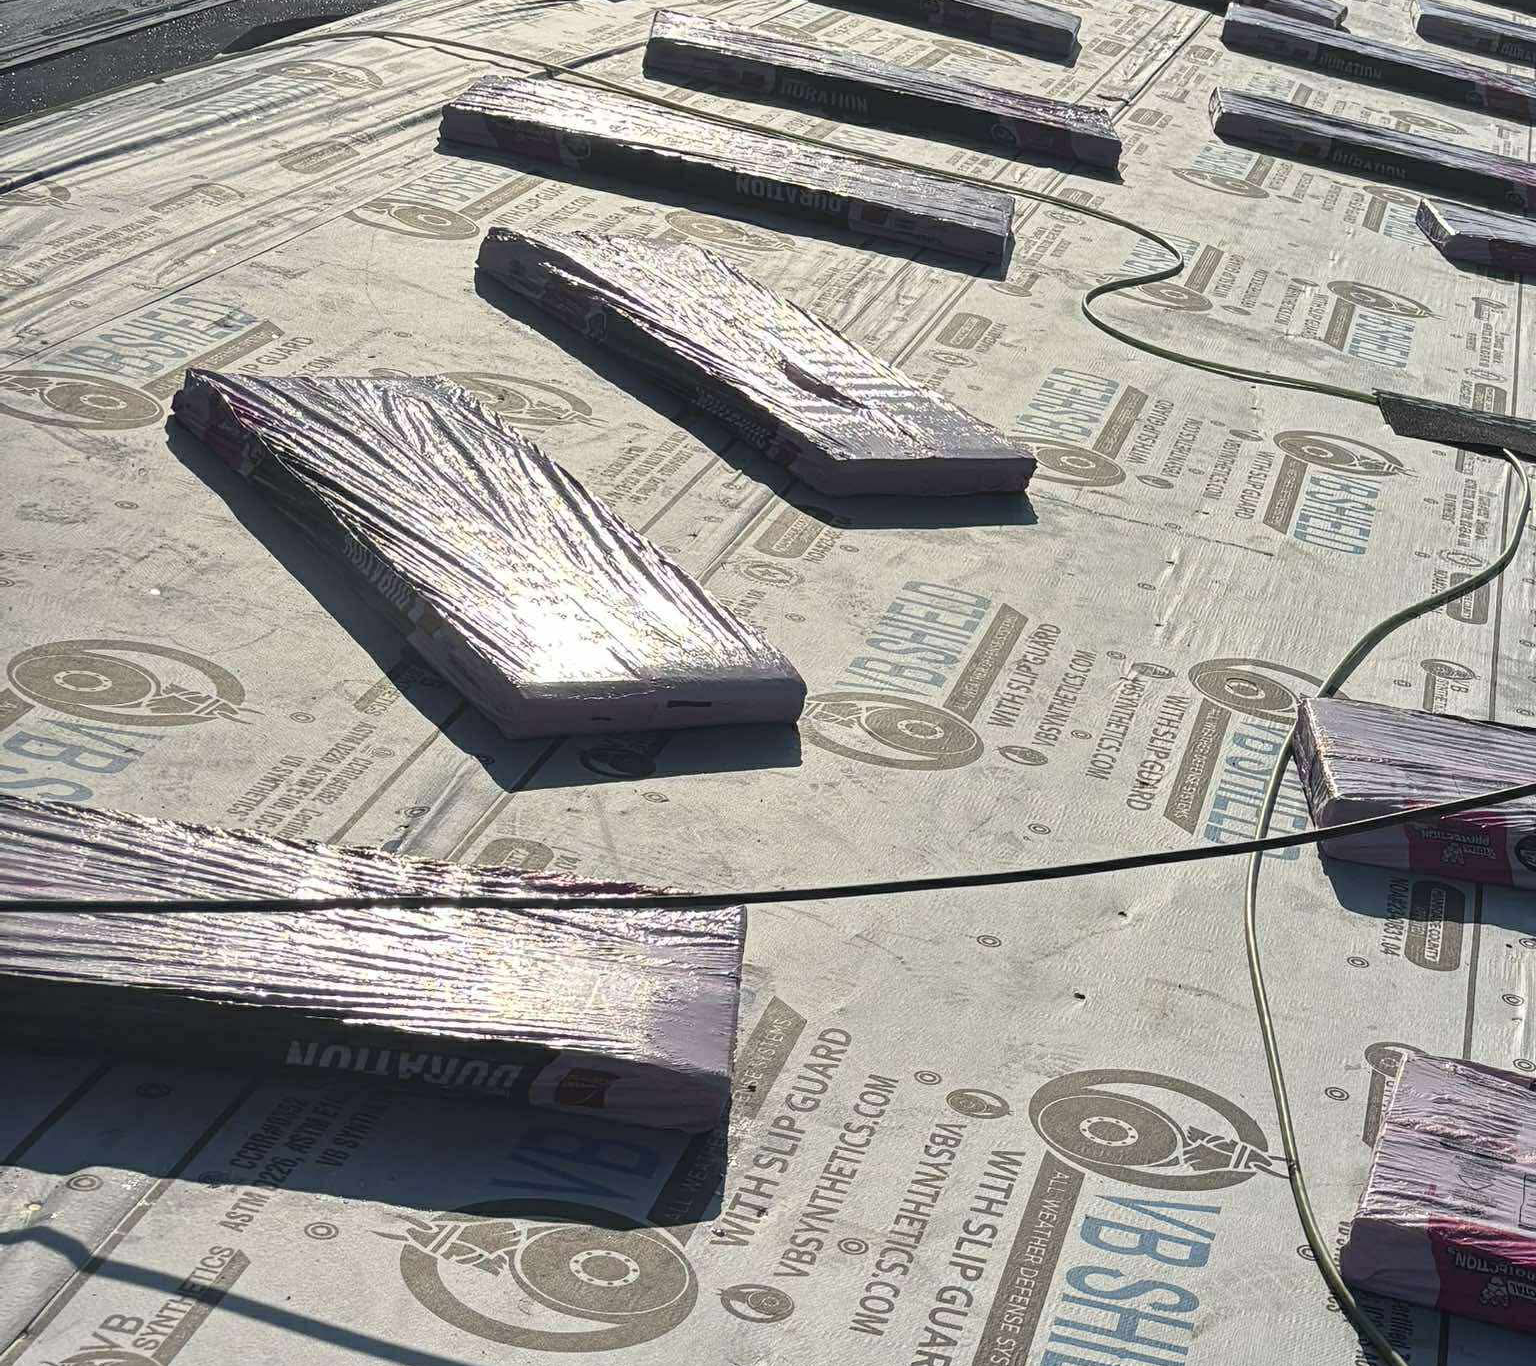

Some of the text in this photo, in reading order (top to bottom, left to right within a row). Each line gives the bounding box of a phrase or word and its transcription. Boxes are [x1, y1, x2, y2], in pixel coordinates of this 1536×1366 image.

[735, 173, 844, 214] DURATION
[256, 336, 314, 366] GUARD
[988, 623, 1062, 729] WITH SLIP GUARD
[1156, 695, 1189, 731] WITH
[710, 1174, 780, 1246] WITH
[753, 1114, 805, 1174] SLIP
[785, 1027, 852, 1112] GUARD
[773, 1074, 899, 1277] VBSYNTHETICS.COM
[970, 1149, 1026, 1219] WITH
[1047, 1171, 1071, 1203] ALL
[218, 1190, 270, 1234] ASTM
[849, 1122, 967, 1337] VBSYNTHETICS.COM
[1026, 1197, 1063, 1266] WEATHER
[947, 1217, 999, 1283] SLIP
[79, 1313, 145, 1352] VB
[131, 1245, 236, 1352] SYNTHETICS
[1000, 1266, 1037, 1335] DEFENSE
